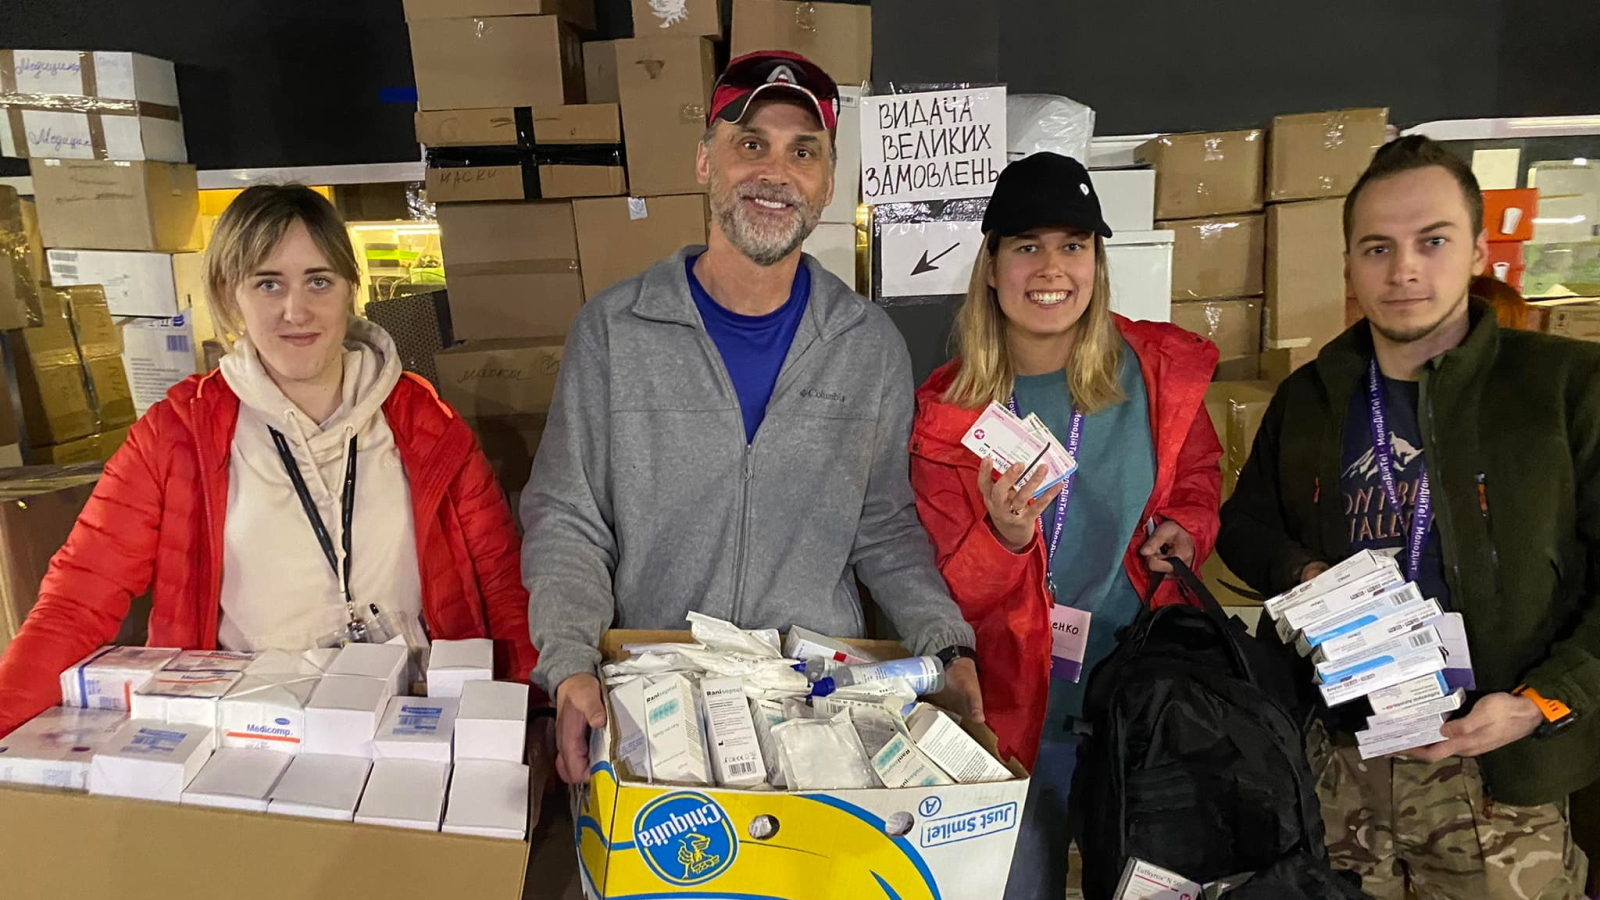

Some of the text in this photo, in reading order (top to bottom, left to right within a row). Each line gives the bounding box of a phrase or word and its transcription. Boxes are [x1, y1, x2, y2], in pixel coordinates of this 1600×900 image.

[878, 95, 973, 129] ВИДАЧА
[882, 124, 992, 162] ВЕЛИКИХ
[865, 158, 999, 197] ЗАМОВЛЕНЬ
[808, 388, 845, 402] Columbia
[925, 799, 937, 814] A
[927, 806, 1012, 843] Just Smile!
[638, 804, 721, 848] Chiquita
